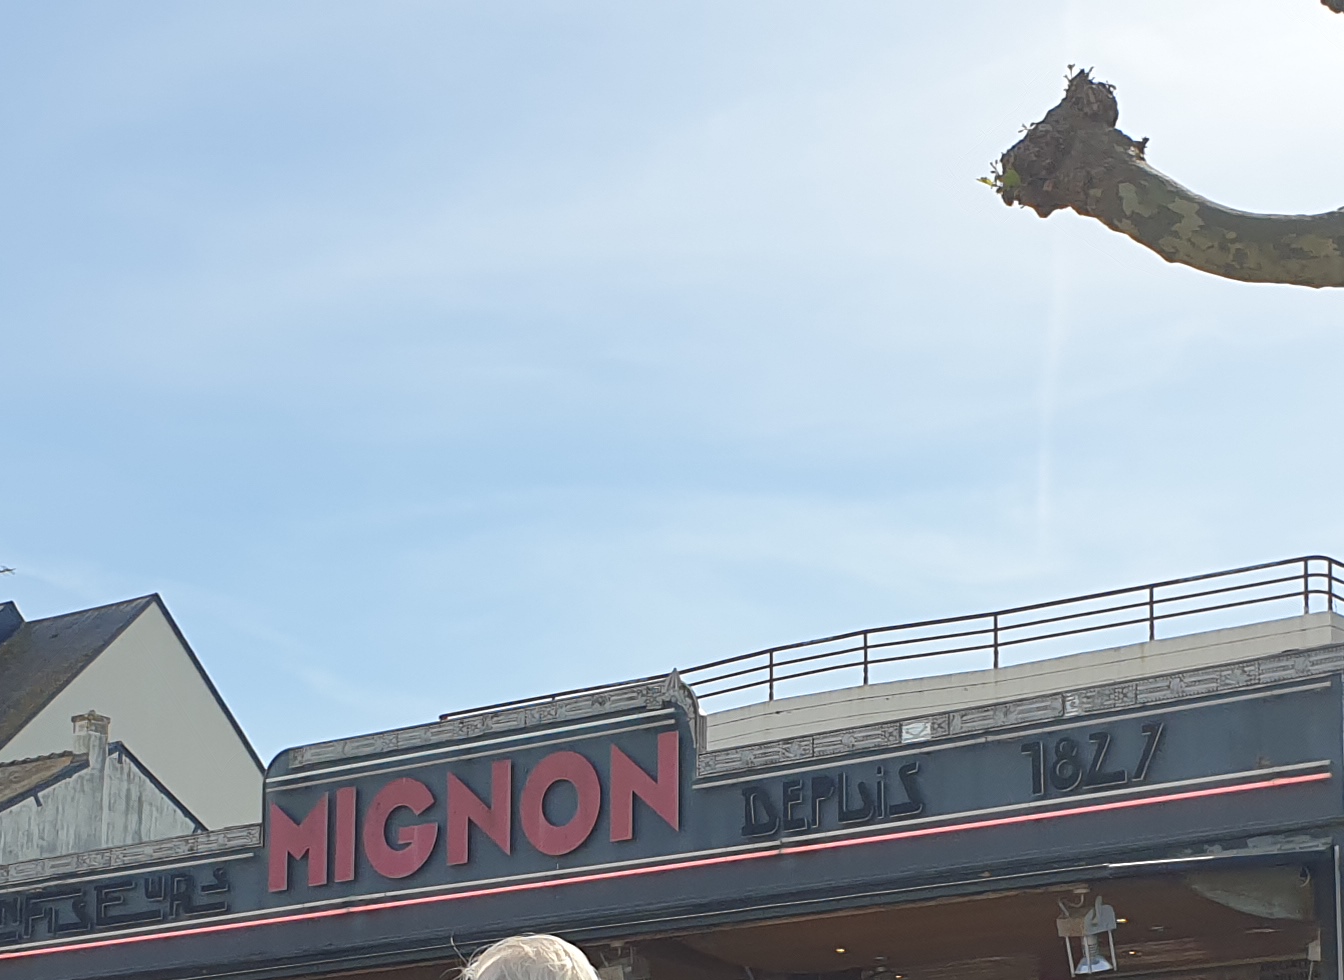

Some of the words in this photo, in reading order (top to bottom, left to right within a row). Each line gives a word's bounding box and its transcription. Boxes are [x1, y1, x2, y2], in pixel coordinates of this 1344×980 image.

[267, 730, 679, 893] MIGNON
[741, 761, 925, 838] DEPUIS
[1020, 721, 1166, 797] 1827
